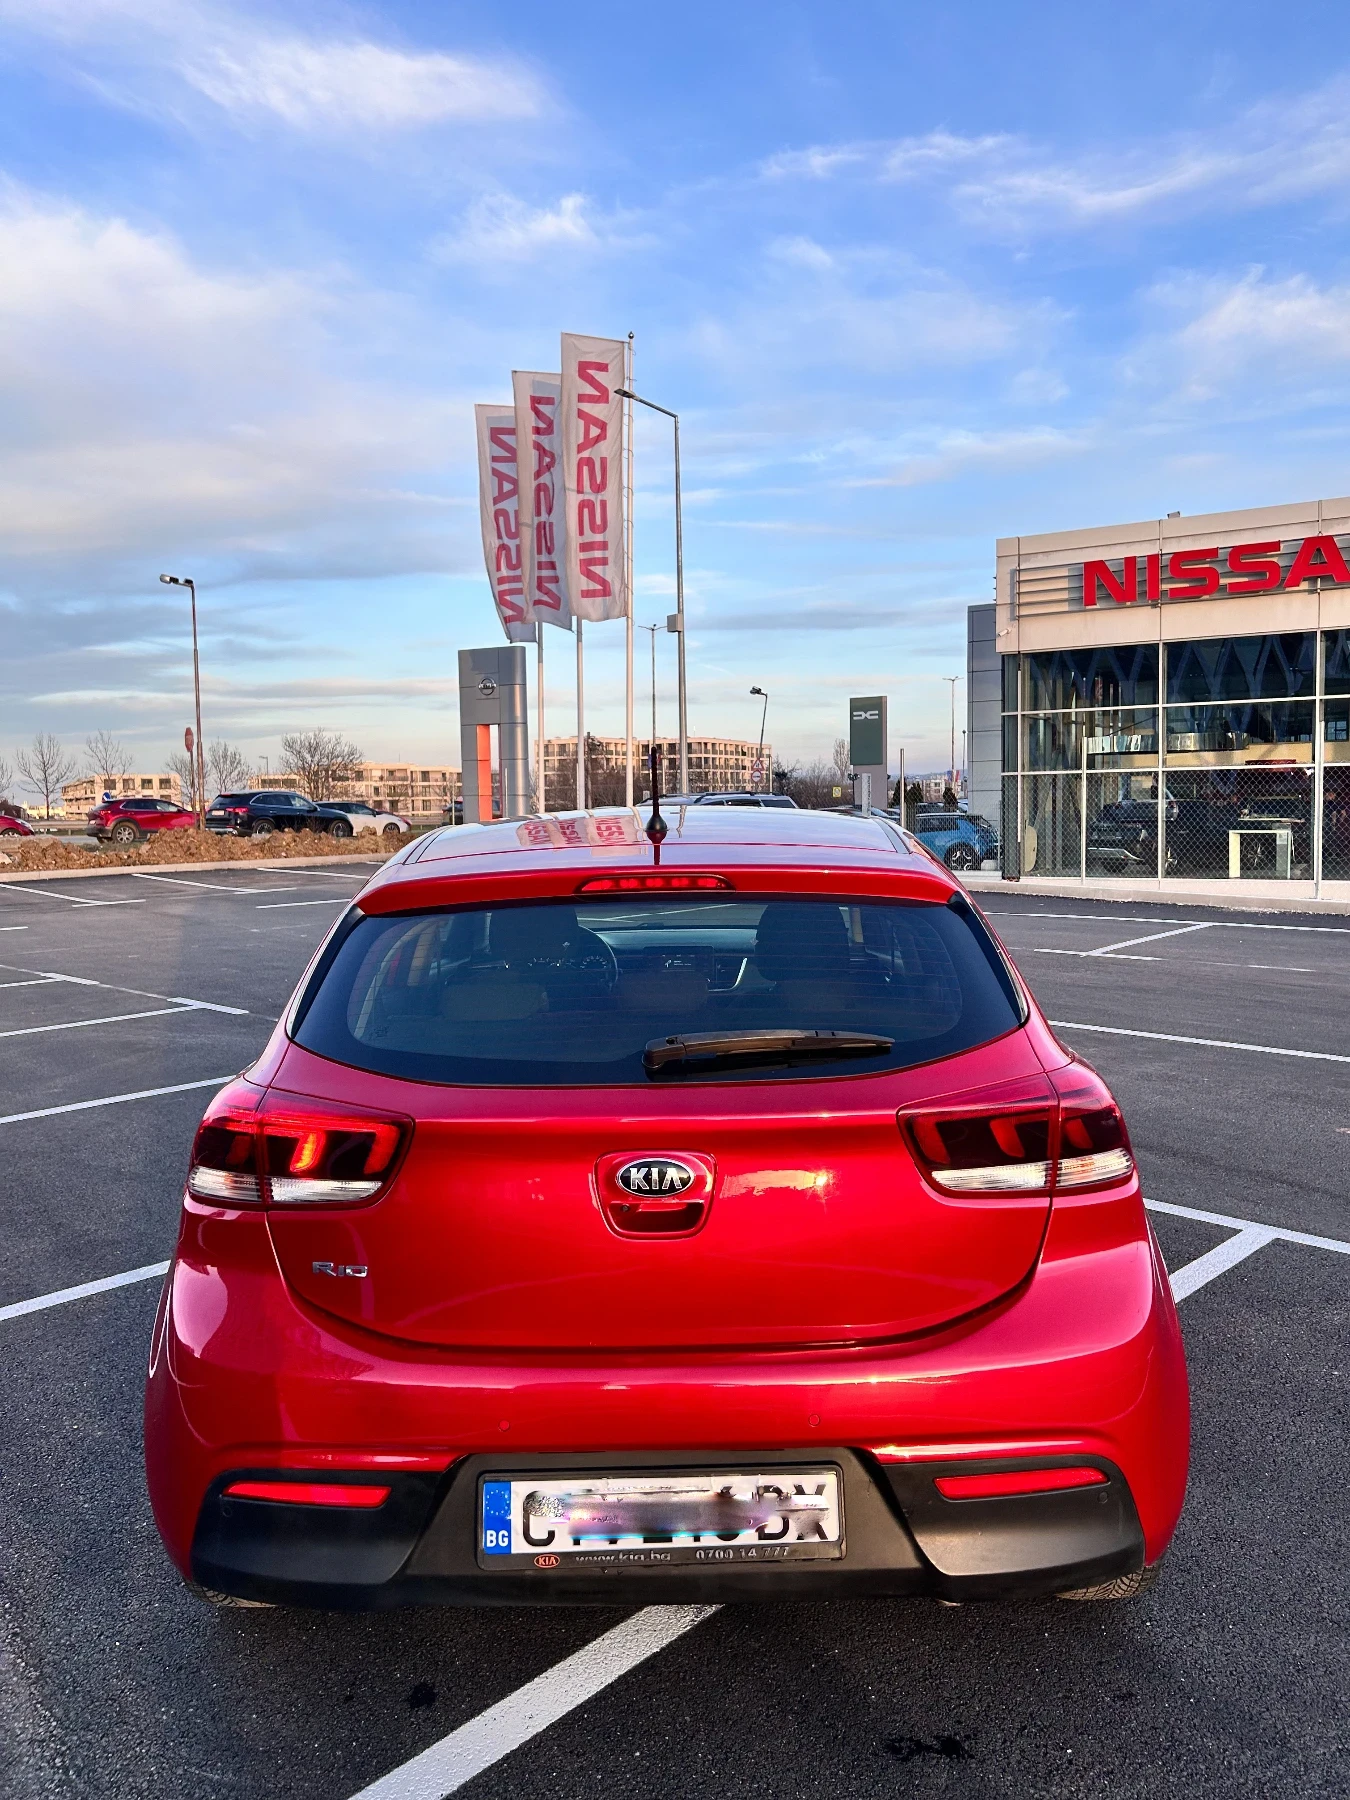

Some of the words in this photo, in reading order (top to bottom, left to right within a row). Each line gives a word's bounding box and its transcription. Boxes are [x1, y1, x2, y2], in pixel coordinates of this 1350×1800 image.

[1083, 535, 1350, 607] NISSA
[630, 1167, 683, 1190] KIA
[486, 1529, 509, 1548] BG
[538, 1556, 557, 1566] KIA
[575, 1550, 671, 1564] www.kia.bg
[695, 1549, 734, 1560] 0700
[739, 1547, 757, 1559] 14
[761, 1546, 790, 1558] 777
